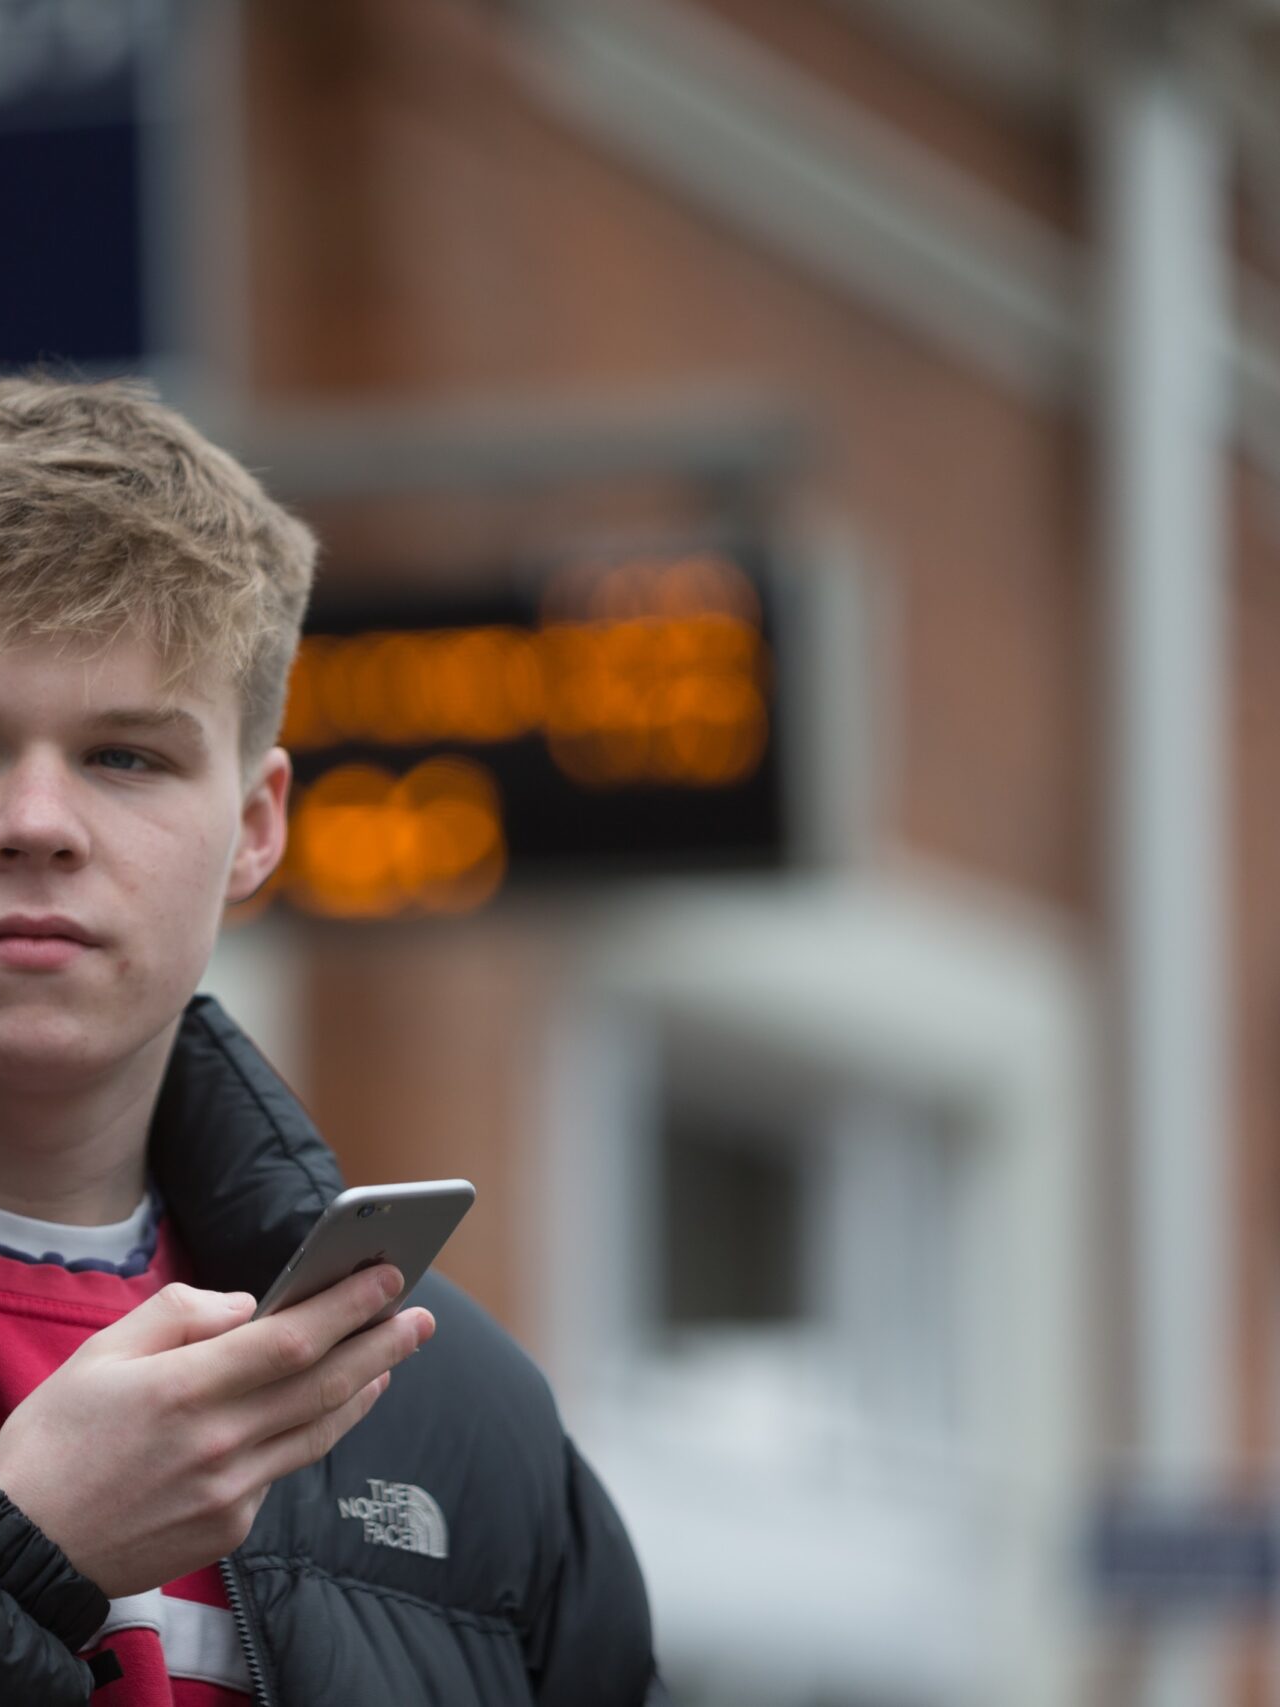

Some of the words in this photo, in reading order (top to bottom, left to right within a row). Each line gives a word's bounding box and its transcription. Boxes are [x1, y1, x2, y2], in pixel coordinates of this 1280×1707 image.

[367, 1478, 409, 1504] THE
[337, 1497, 410, 1528] NORTH
[363, 1521, 414, 1550] FACE
